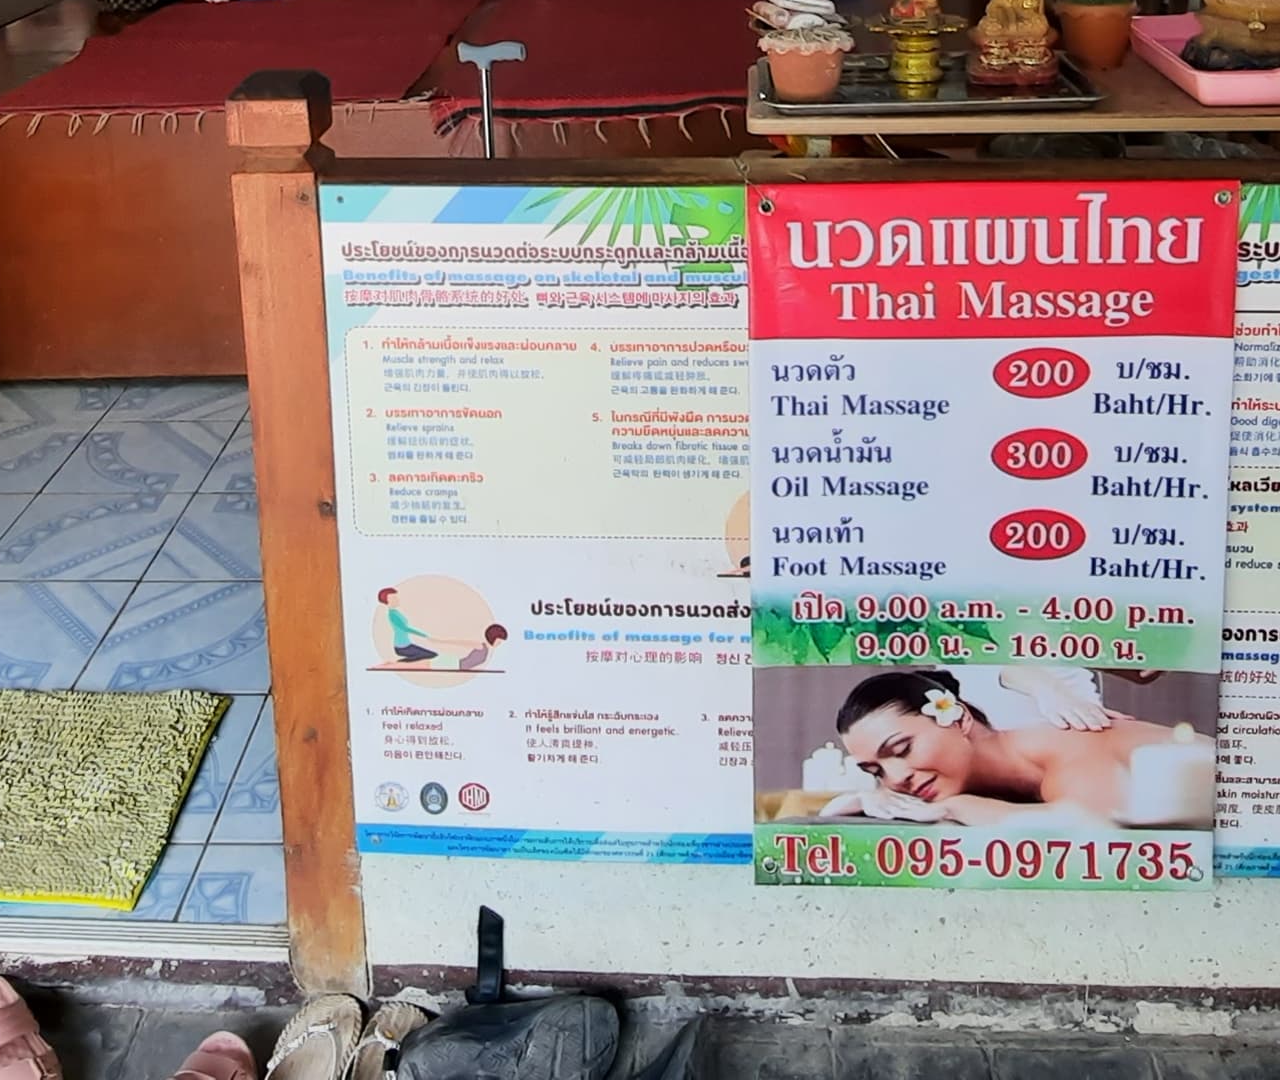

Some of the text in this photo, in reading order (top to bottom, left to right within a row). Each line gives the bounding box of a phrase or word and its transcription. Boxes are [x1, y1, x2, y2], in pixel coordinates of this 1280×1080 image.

[786, 192, 1204, 269] นวดแผนไทย
[343, 270, 419, 284] Benefits
[423, 270, 444, 284] of
[448, 272, 529, 288] massage
[534, 273, 558, 284] on
[562, 272, 639, 285] skeletal
[643, 272, 680, 284] and
[831, 280, 1155, 326] Thai Massage
[382, 355, 505, 366] Muscle strength and relax
[647, 357, 668, 368] pain
[670, 356, 689, 367] and
[692, 356, 730, 367] reduces
[770, 354, 856, 382] นวดตัว
[1007, 359, 1075, 387] 200
[1116, 357, 1190, 381] บ/ชม.
[770, 392, 1212, 422] Thai Massage Baht/Hr.
[1230, 416, 1258, 426] Good
[770, 428, 893, 465] นวดน้ำมัน
[1006, 441, 1072, 469] 300
[1114, 440, 1188, 464] บ/ชม.
[424, 488, 458, 499] cramps
[770, 474, 1210, 502] Oil Massage Baht/Hr.
[772, 518, 865, 545] นวดเท้า
[1004, 522, 1071, 550] 200
[1112, 523, 1185, 547] บ/ชม.
[771, 556, 1207, 582] Foot Massage Baht/Hr.
[1235, 558, 1273, 569] reduce
[792, 592, 844, 623] เปิด
[857, 595, 929, 621] 9.00
[939, 598, 1004, 621] a.m.
[1041, 596, 1114, 622] 4.00
[1126, 601, 1195, 629] p.m.
[524, 629, 734, 646] Benefits of massage for
[857, 633, 927, 659] 9.00
[939, 636, 971, 659] น.
[1011, 634, 1101, 660] 16.00
[1113, 638, 1146, 662] น.
[382, 721, 443, 731] Feel relaxed
[535, 724, 560, 734] feels
[563, 724, 602, 735] brilliant
[605, 725, 625, 735] and
[628, 726, 679, 739] energetic.
[1216, 787, 1238, 799] skin
[775, 834, 858, 875] Tel.
[875, 836, 1194, 881] 095-0971735
